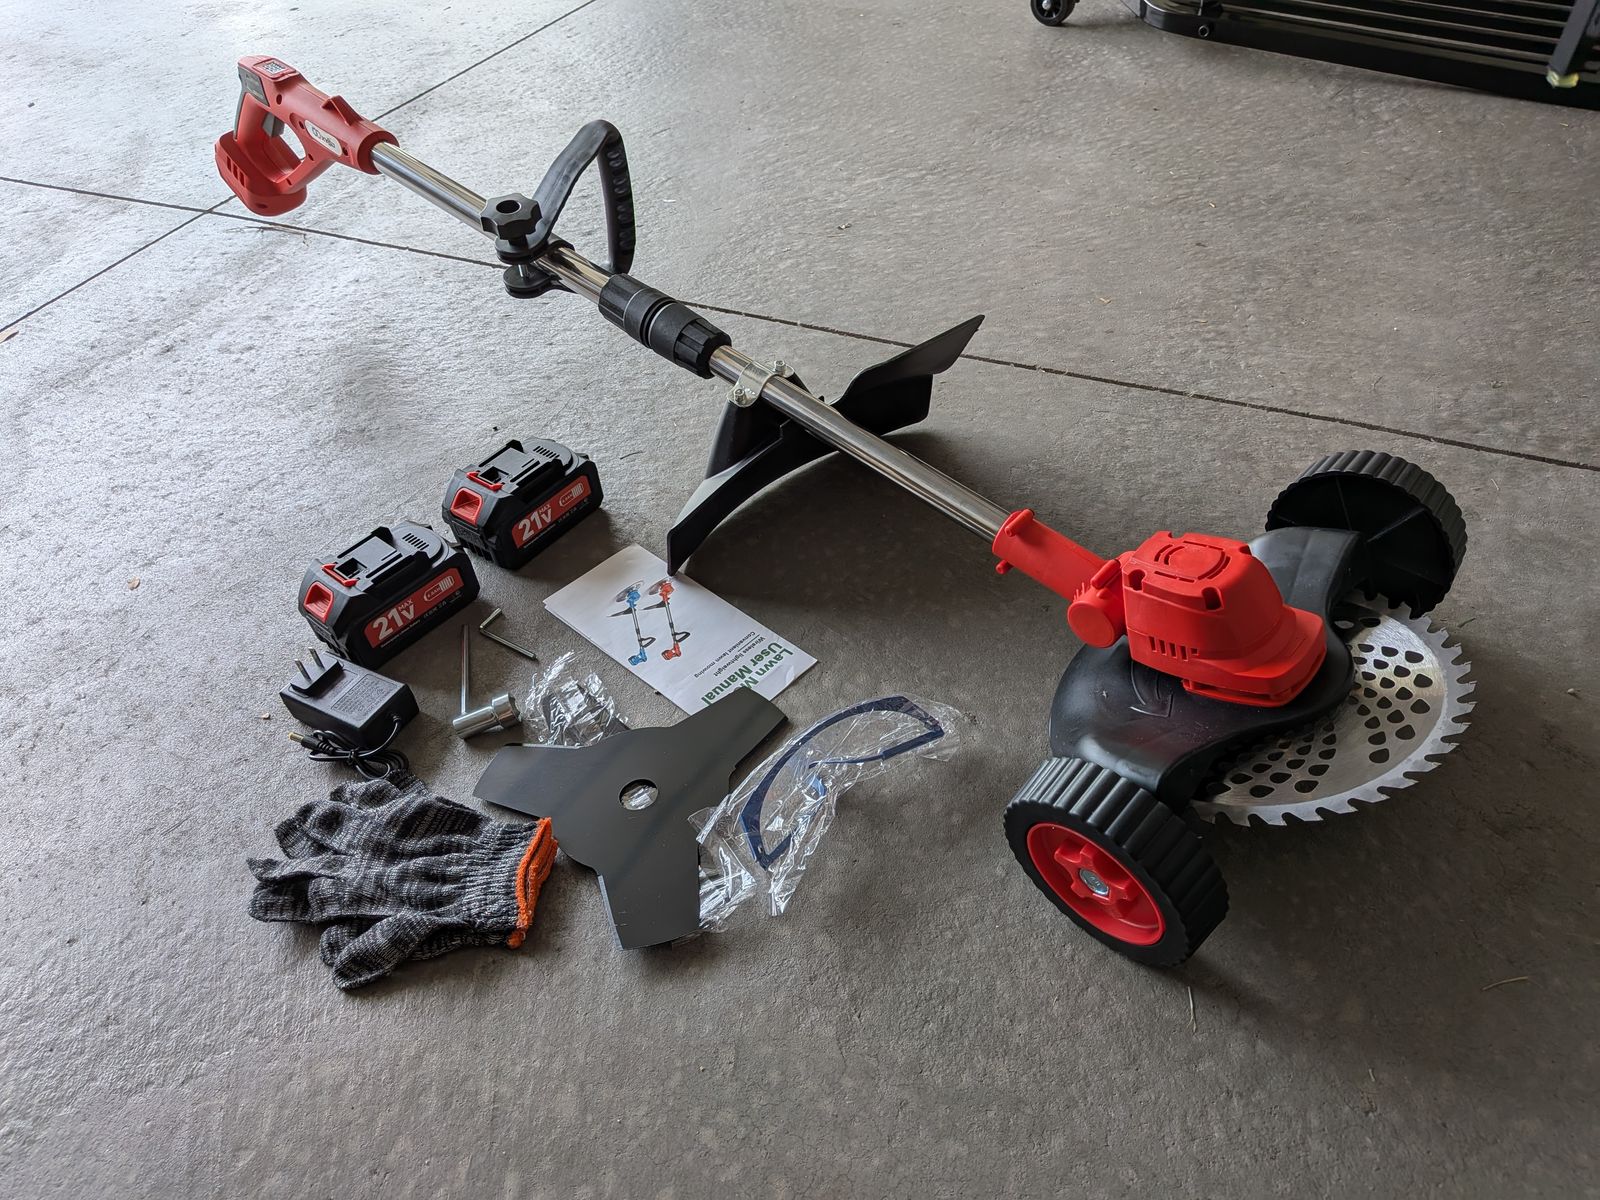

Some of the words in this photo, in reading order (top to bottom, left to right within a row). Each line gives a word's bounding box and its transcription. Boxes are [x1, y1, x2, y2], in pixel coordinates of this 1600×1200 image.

[398, 598, 414, 611] MAX
[727, 631, 756, 653] Convenient
[743, 636, 766, 654] Wireless
[713, 653, 745, 677] lightweight
[715, 651, 730, 663] lawn
[750, 642, 783, 666] User
[755, 647, 794, 677] Lawn
[694, 661, 716, 678] mowing
[701, 664, 753, 706] Manual
